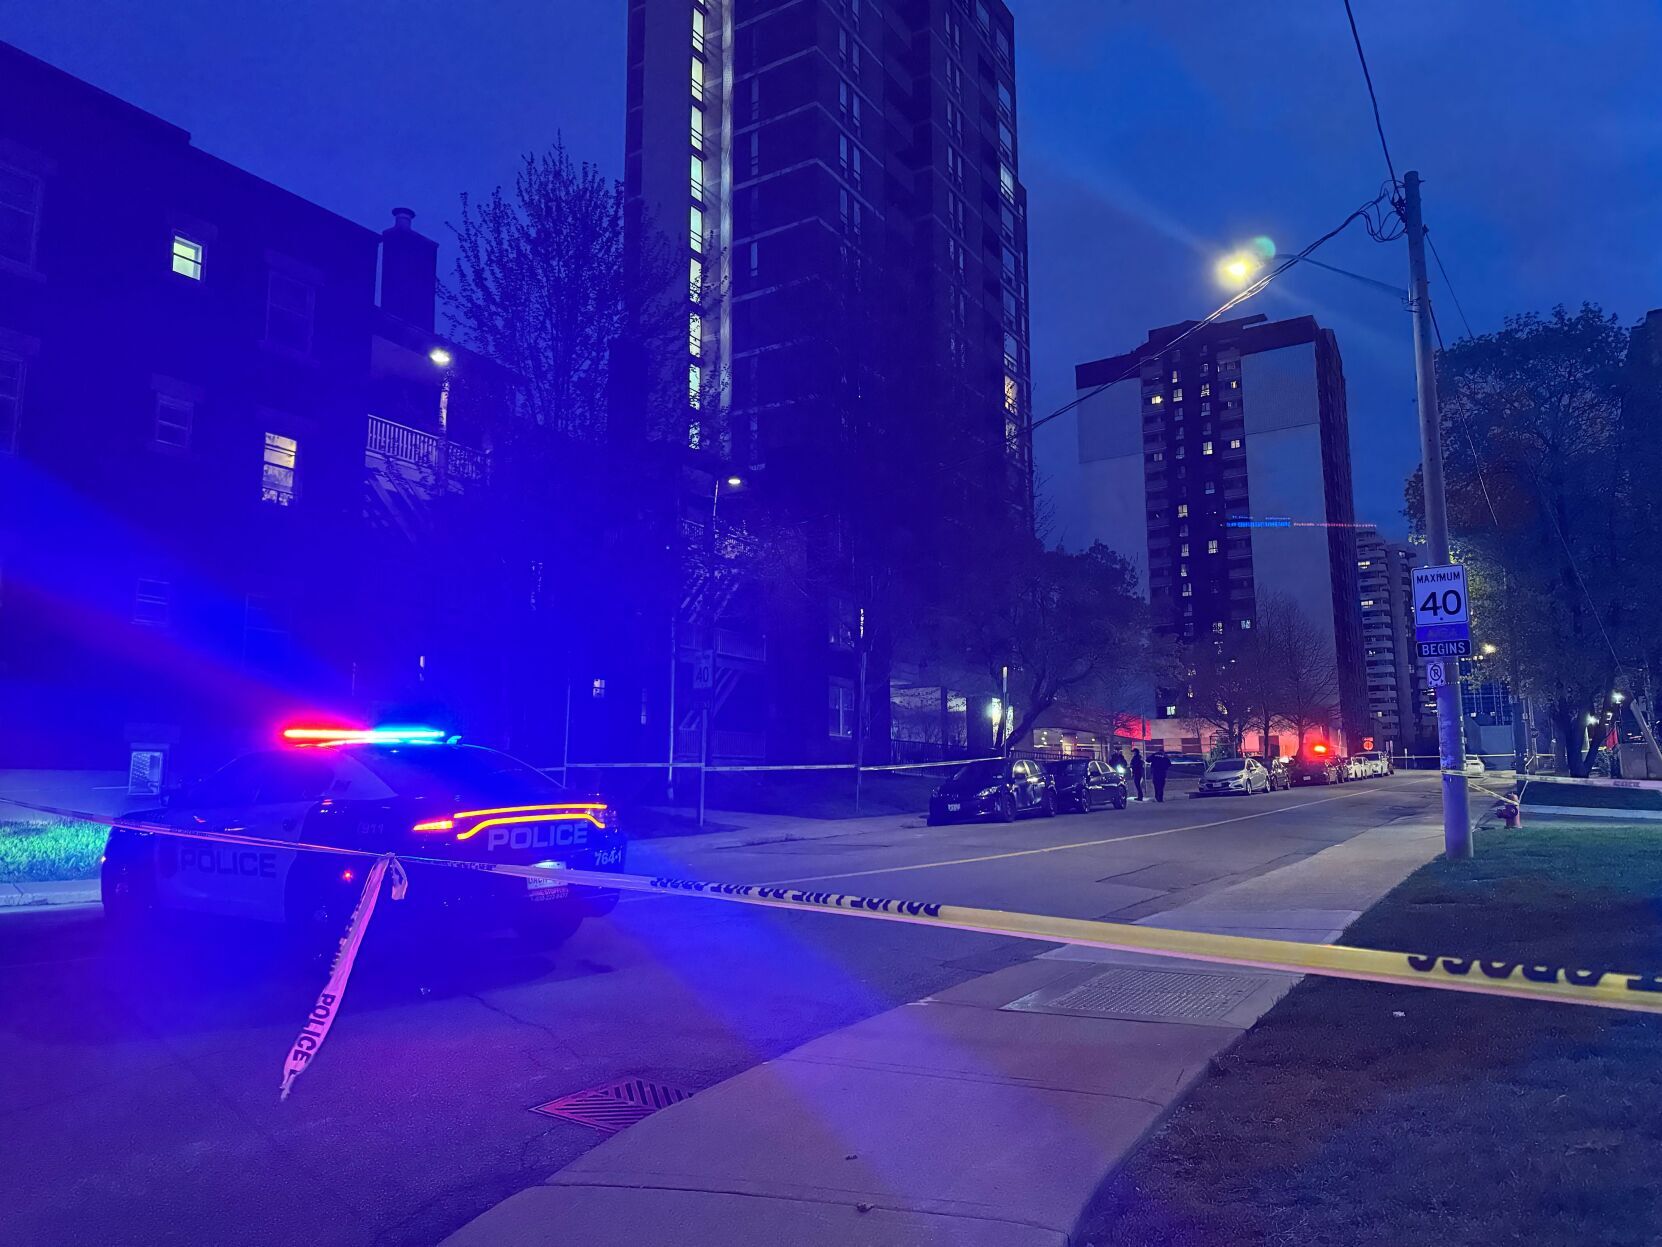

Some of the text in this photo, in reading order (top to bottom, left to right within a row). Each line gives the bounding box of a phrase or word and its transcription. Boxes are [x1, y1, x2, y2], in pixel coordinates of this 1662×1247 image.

[1416, 571, 1460, 584] MAXIMUM
[1419, 589, 1462, 616] 40
[1421, 641, 1466, 656] BEGINS
[487, 822, 588, 851] POLICE
[180, 848, 277, 878] POLICE
[292, 993, 337, 1064] POLICE
